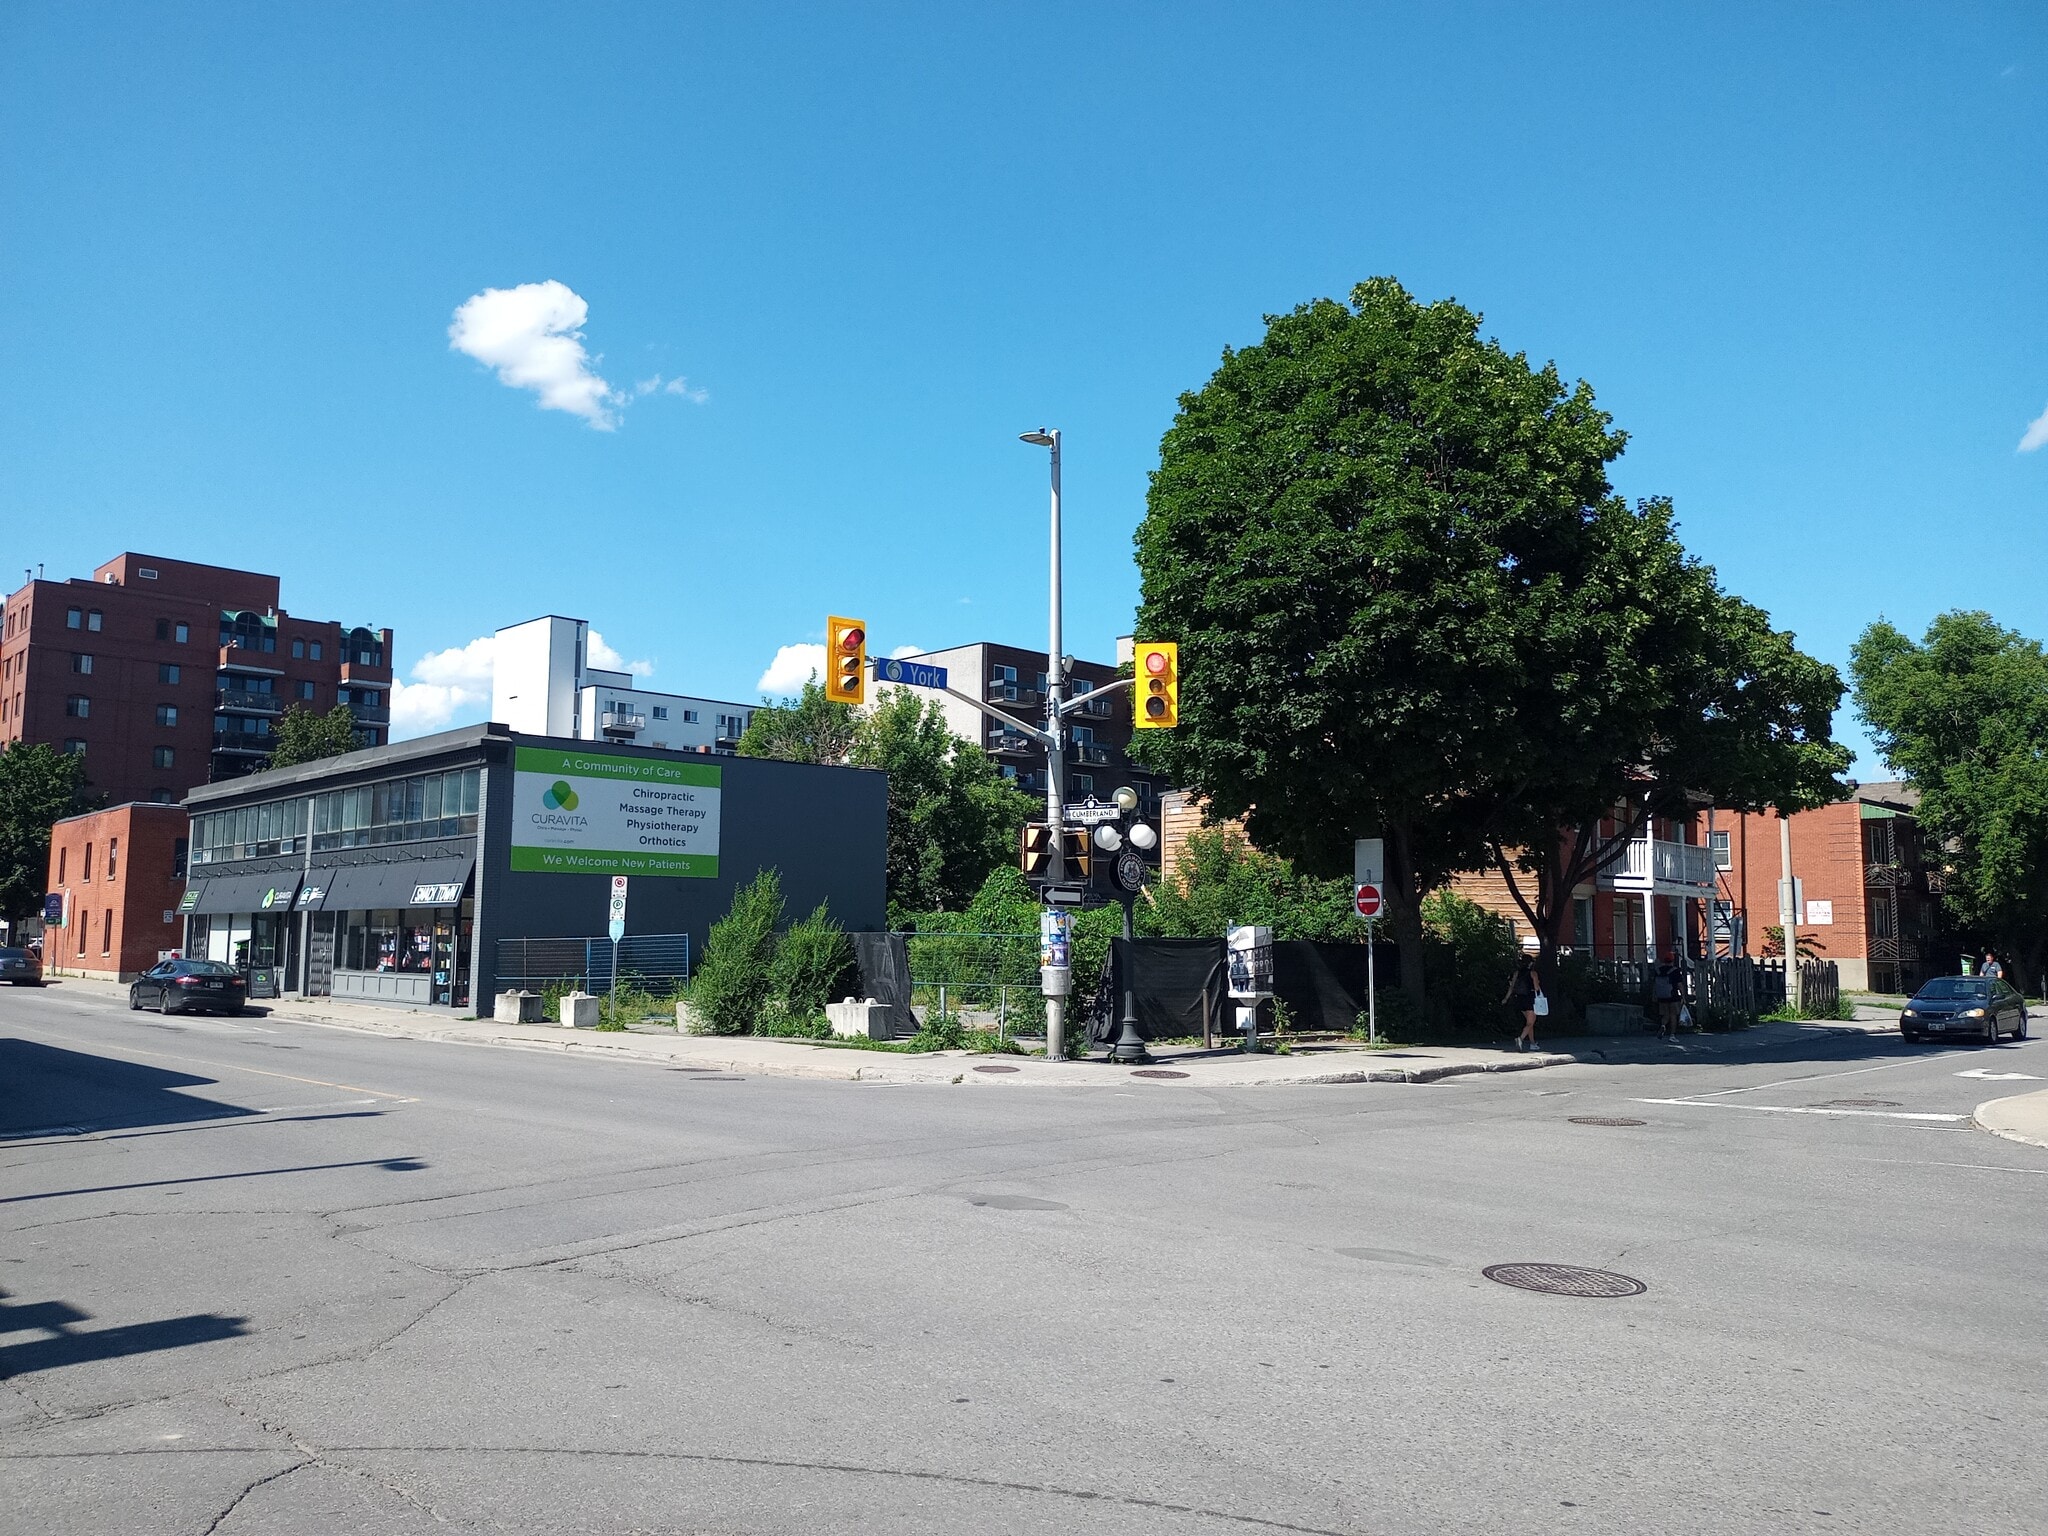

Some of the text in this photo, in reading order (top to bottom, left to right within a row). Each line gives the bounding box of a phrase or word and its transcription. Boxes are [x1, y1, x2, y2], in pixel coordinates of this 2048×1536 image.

[910, 665, 940, 687] York
[562, 758, 681, 778] A Community of Care
[633, 788, 695, 801] Chiropractic
[619, 803, 707, 819] Massage Therapy
[1072, 809, 1114, 818] CUMBERLAND
[531, 813, 588, 826] CURAVITA
[626, 819, 699, 833] Physiotherapy
[639, 835, 687, 847] Orthotics
[543, 854, 690, 870] We Welcome New Patients
[436, 885, 459, 901] TOWN
